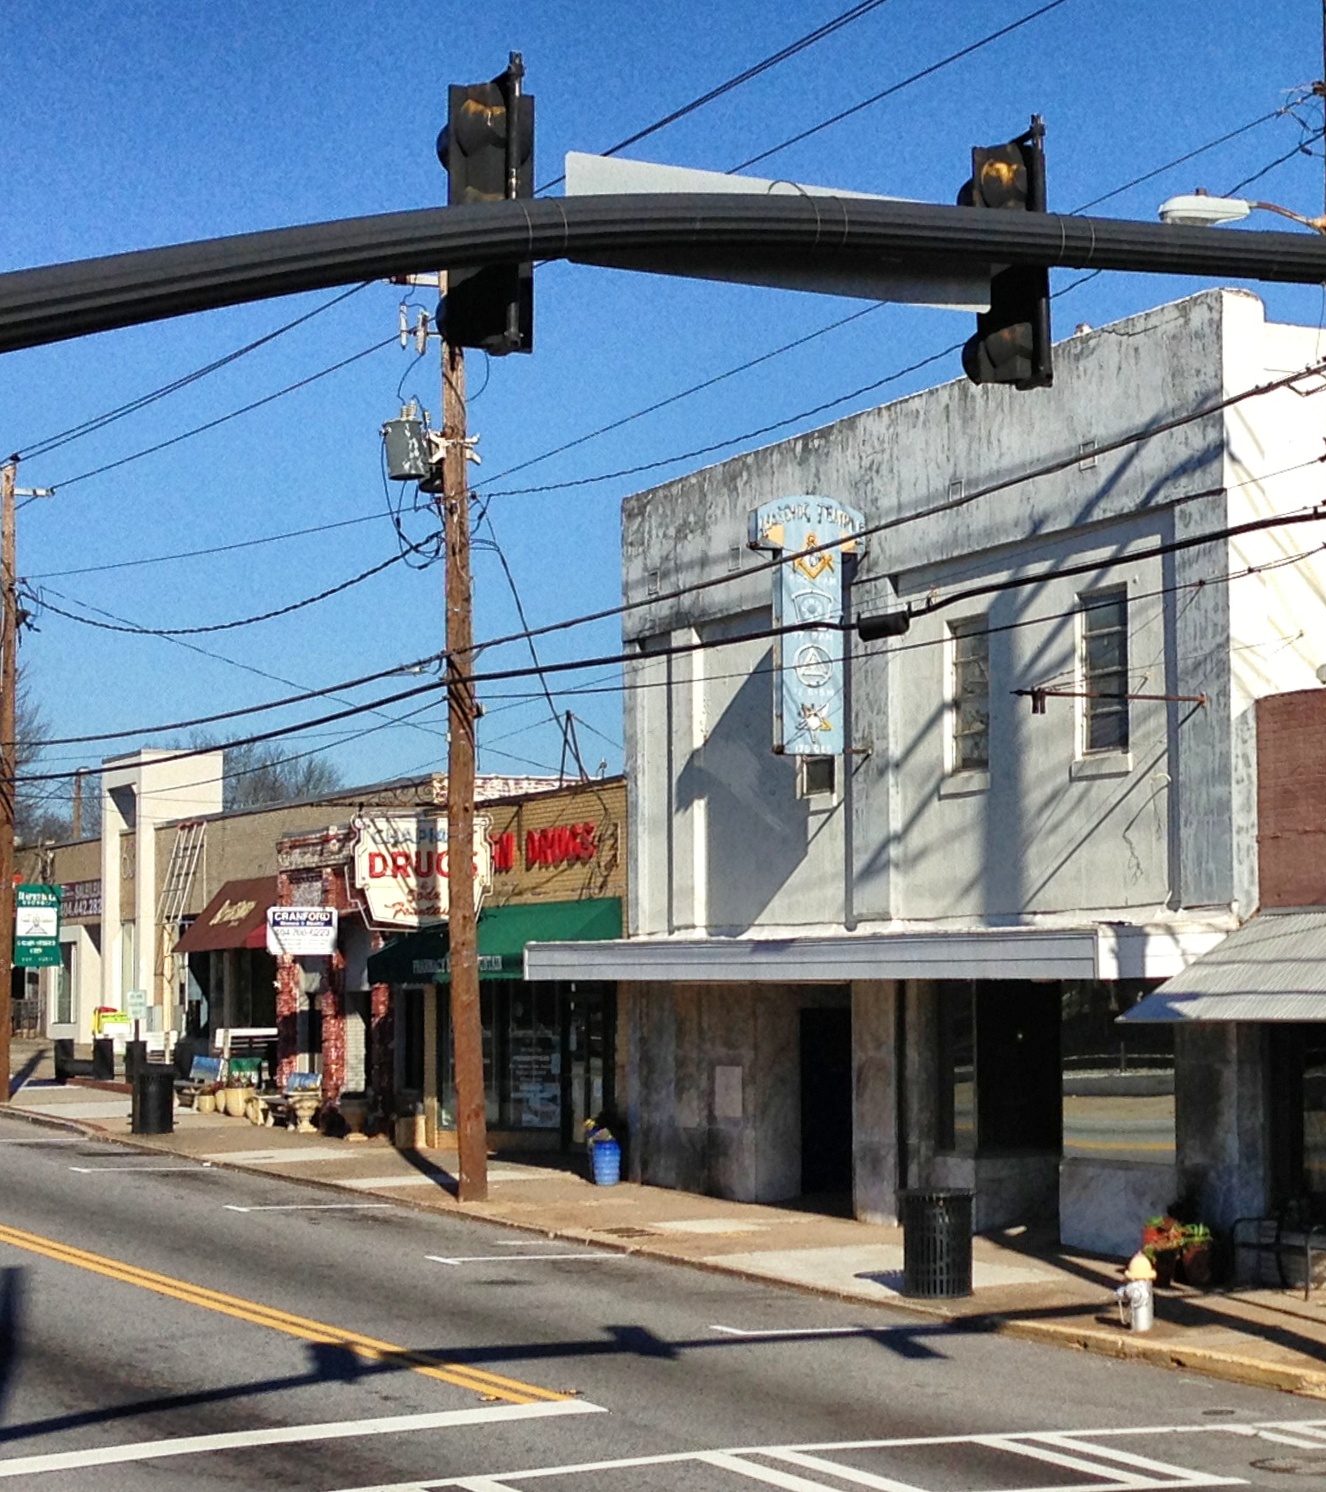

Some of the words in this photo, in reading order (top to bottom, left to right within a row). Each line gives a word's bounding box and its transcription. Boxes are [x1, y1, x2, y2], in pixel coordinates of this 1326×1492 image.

[759, 502, 811, 530] MASONIC
[816, 503, 866, 533] TEMPLE
[526, 821, 597, 868] DRUGS
[274, 911, 331, 922] CRANFORD
